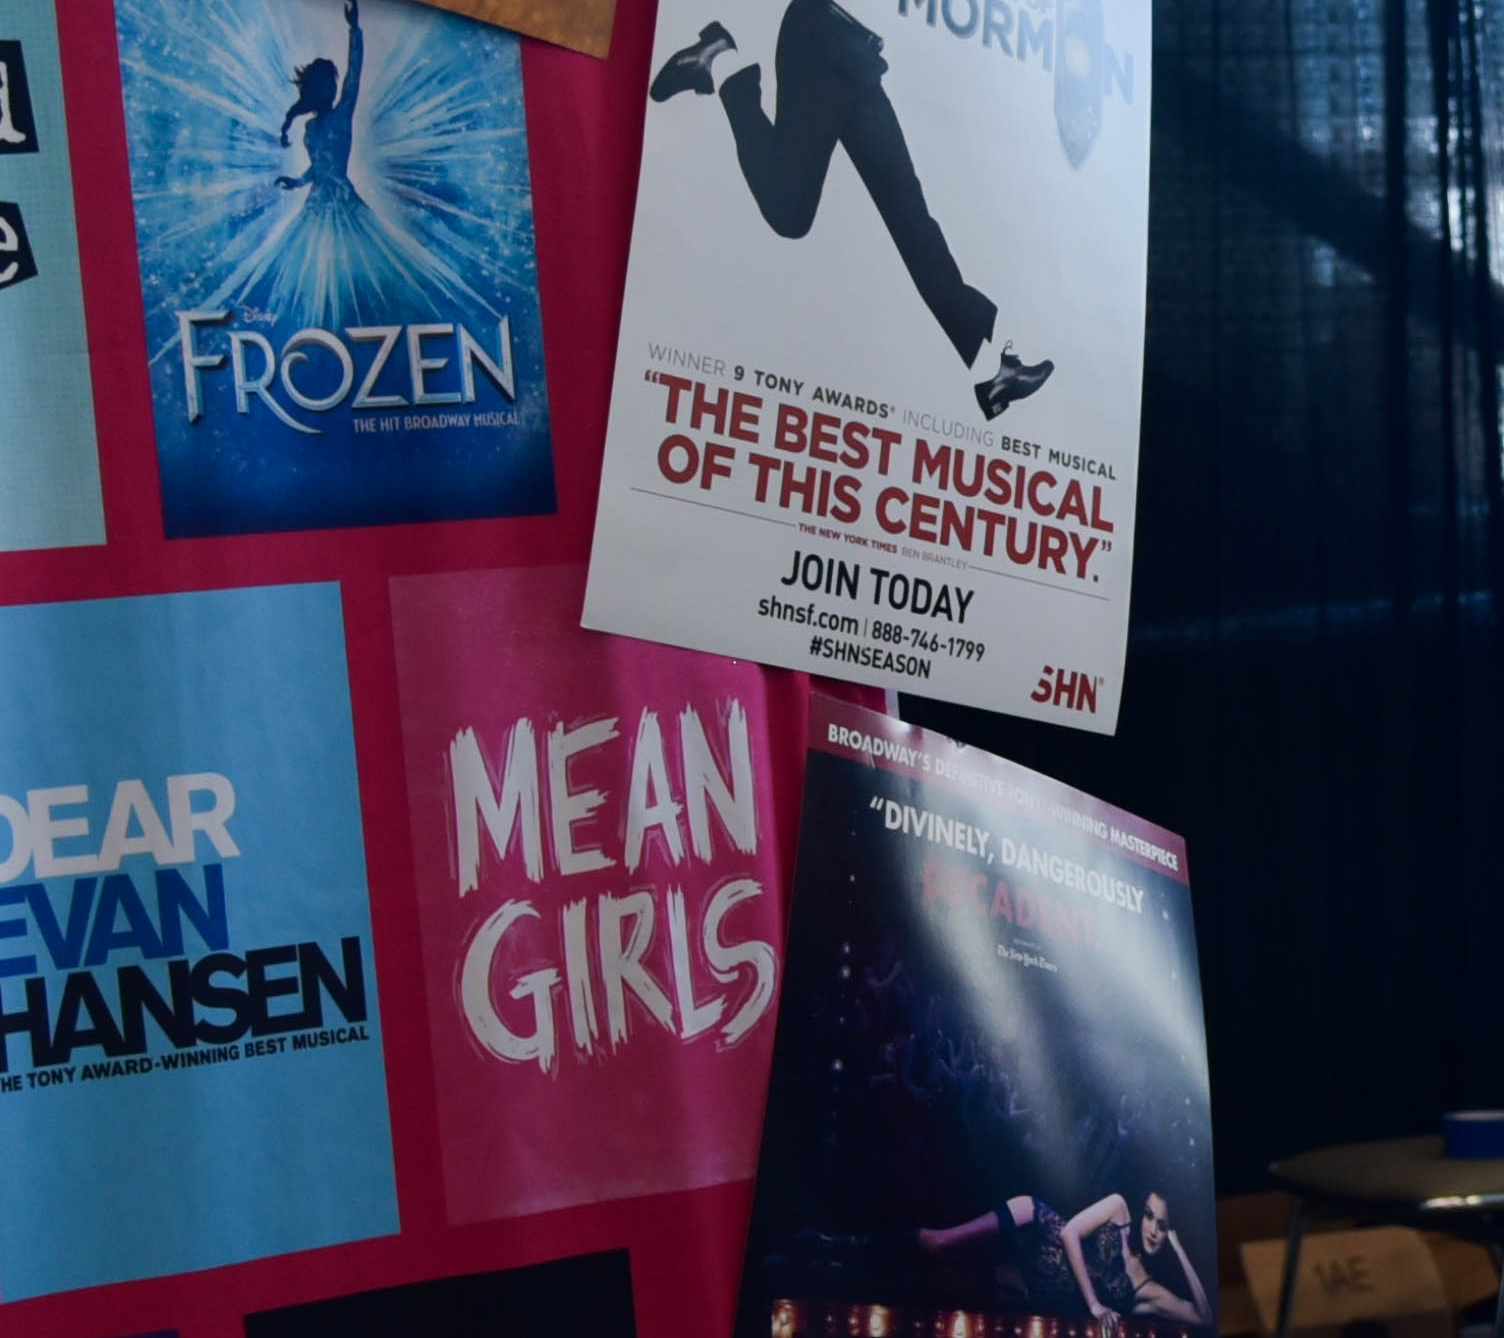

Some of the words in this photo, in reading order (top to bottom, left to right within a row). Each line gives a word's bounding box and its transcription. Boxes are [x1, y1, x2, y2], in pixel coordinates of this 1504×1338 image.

[176, 309, 516, 433] FROZEN
[648, 342, 726, 378] WINNER
[733, 364, 744, 381] 9
[755, 370, 804, 396] TONY
[902, 408, 994, 448] INCLUDING
[1001, 436, 1041, 459] BEST
[1048, 448, 1117, 479] MUSICAL
[353, 418, 377, 433] THE
[380, 417, 400, 431] HIT
[405, 415, 470, 430] BROADWAY
[474, 412, 519, 426] MUSICAL
[775, 402, 901, 475] BEST
[912, 439, 1115, 532] MUSICAL
[657, 434, 733, 490] OF
[748, 453, 862, 525] THIS
[758, 595, 859, 636] shnsf.com
[872, 617, 985, 663] 888-746-1799
[781, 550, 859, 602] JOIN
[870, 567, 975, 624] TODAY
[810, 635, 930, 678] #SHNSEASON
[446, 699, 759, 897] MEAN
[1001, 837, 1144, 914] DANGEROUSLY
[459, 879, 779, 1077] GIRLS
